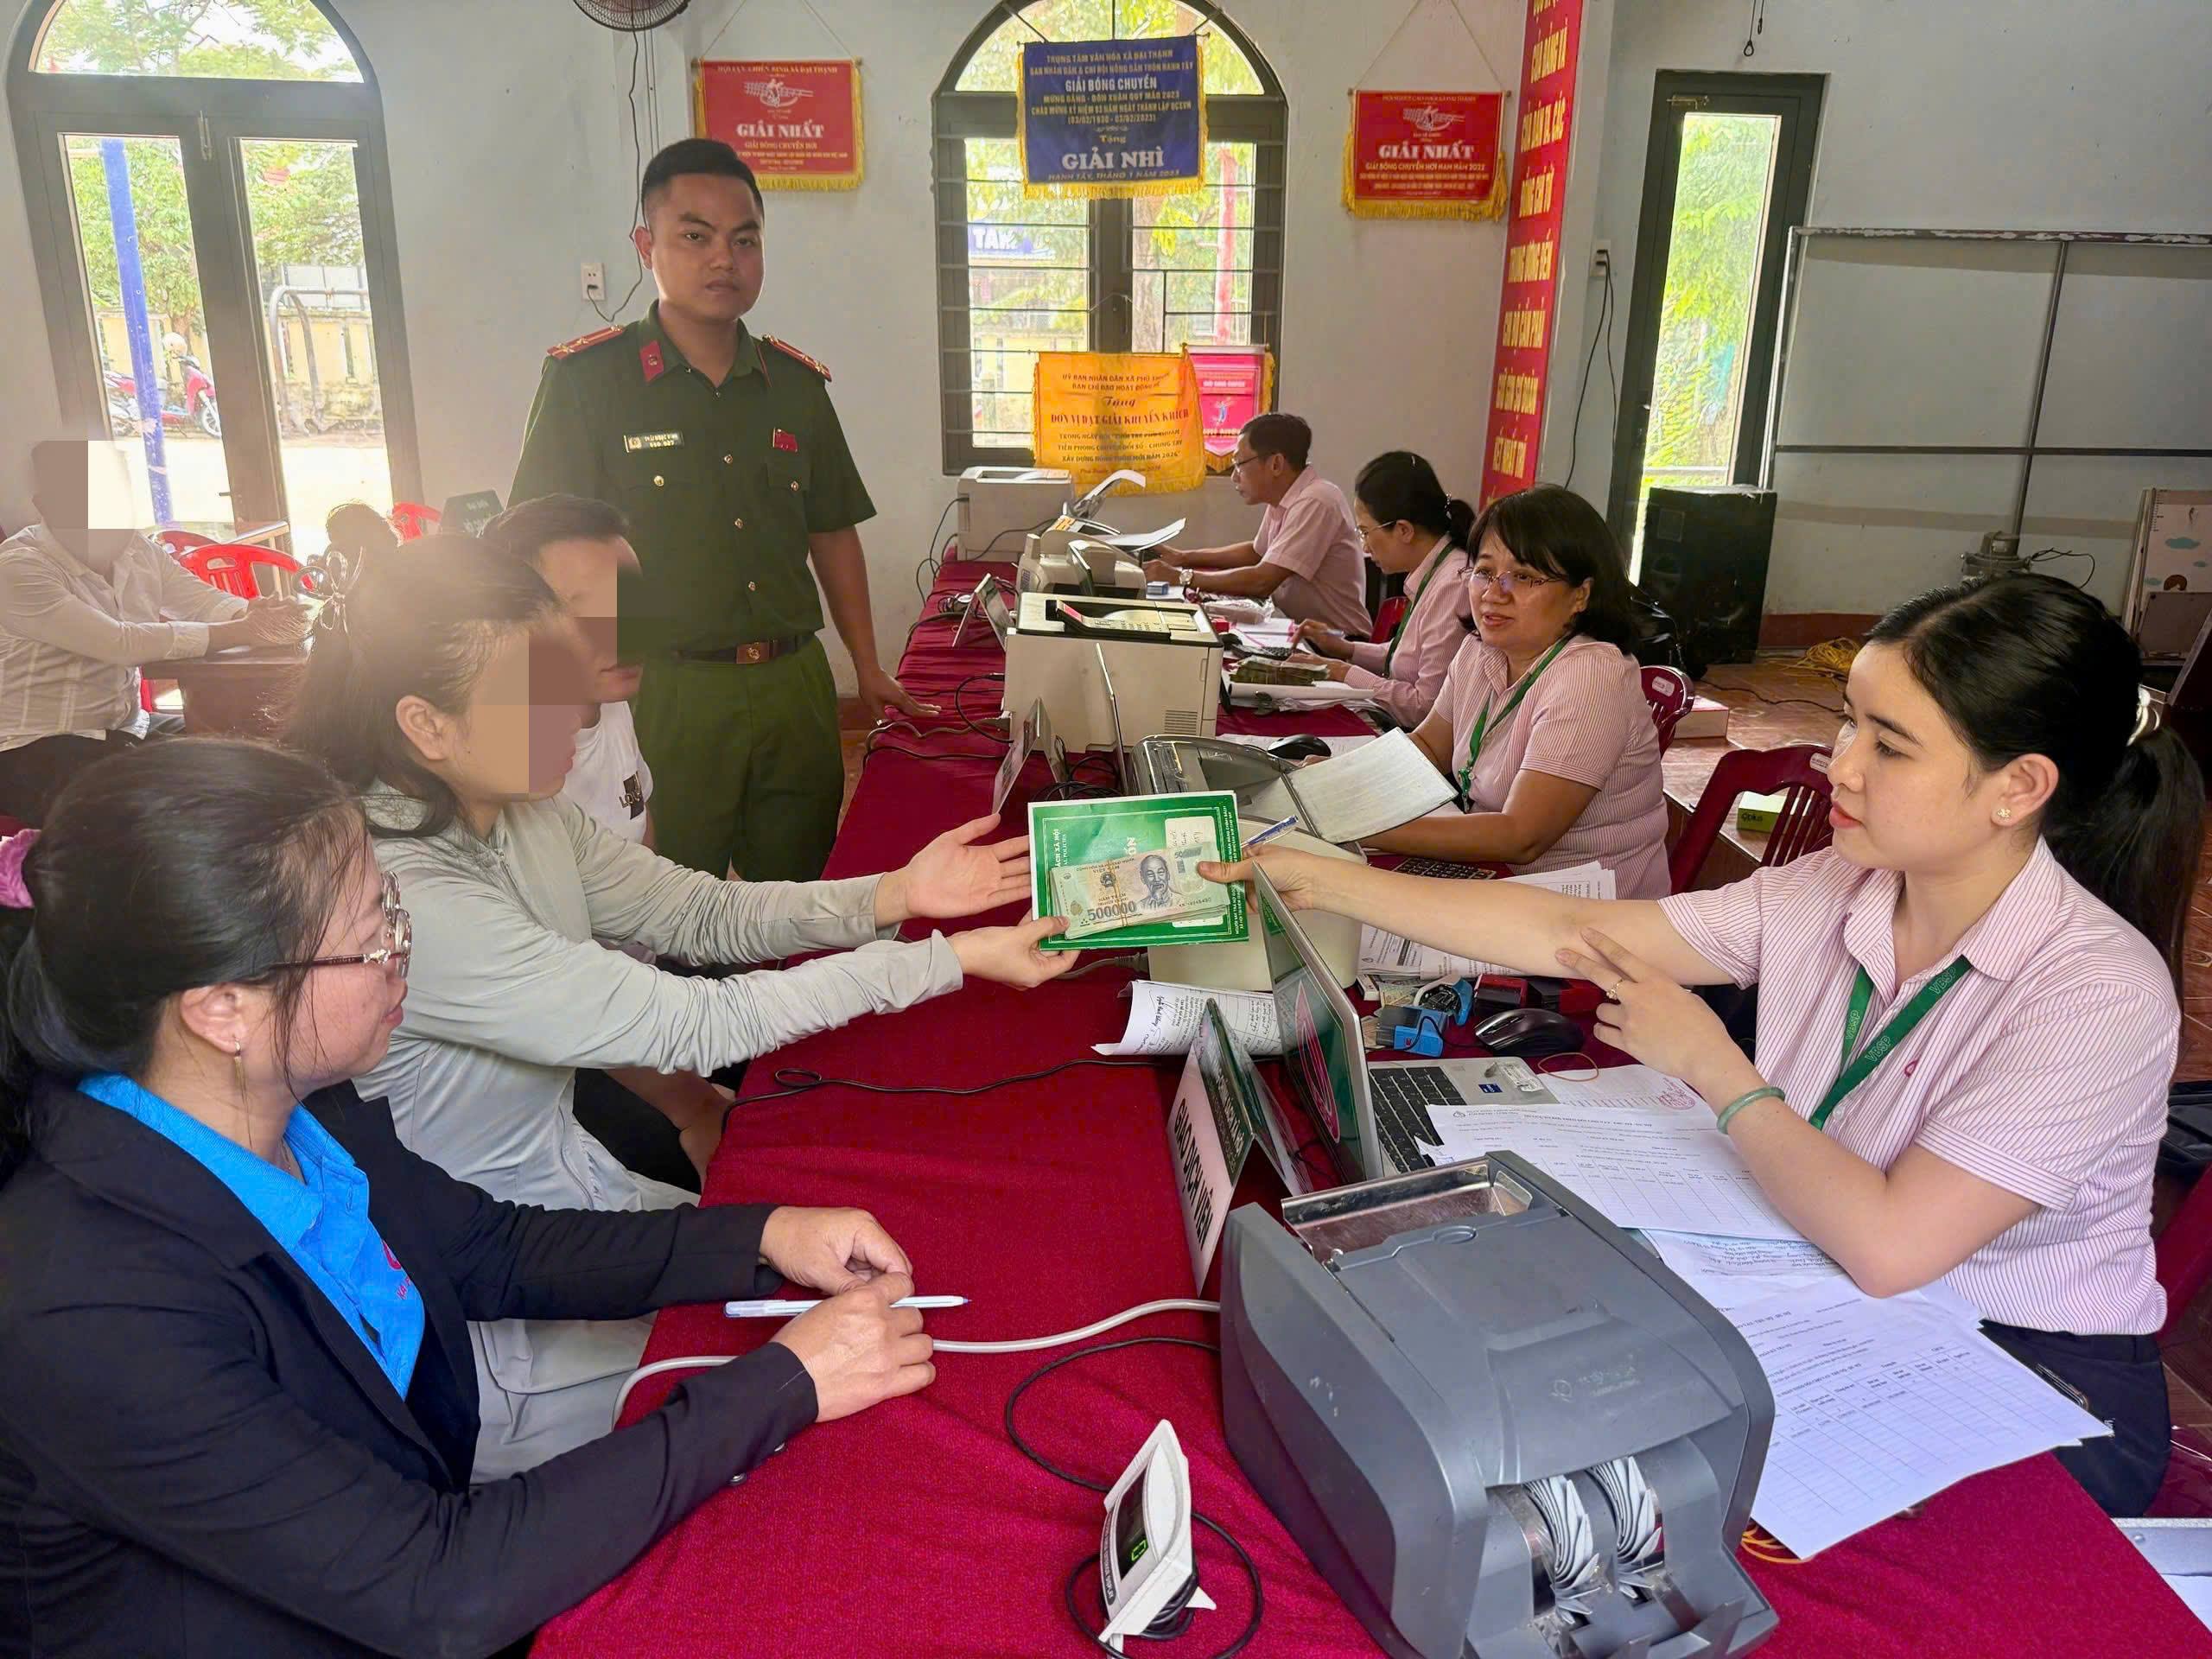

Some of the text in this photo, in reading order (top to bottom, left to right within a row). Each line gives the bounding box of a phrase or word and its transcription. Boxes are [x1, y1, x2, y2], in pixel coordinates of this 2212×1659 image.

[1062, 145, 1165, 170] GIẢI NHÌ
[1087, 900, 1136, 921] 500000
[1929, 966, 1957, 995] VBSP
[1865, 1035, 1892, 1064] VBSP
[1174, 1097, 1195, 1160] GIAO
